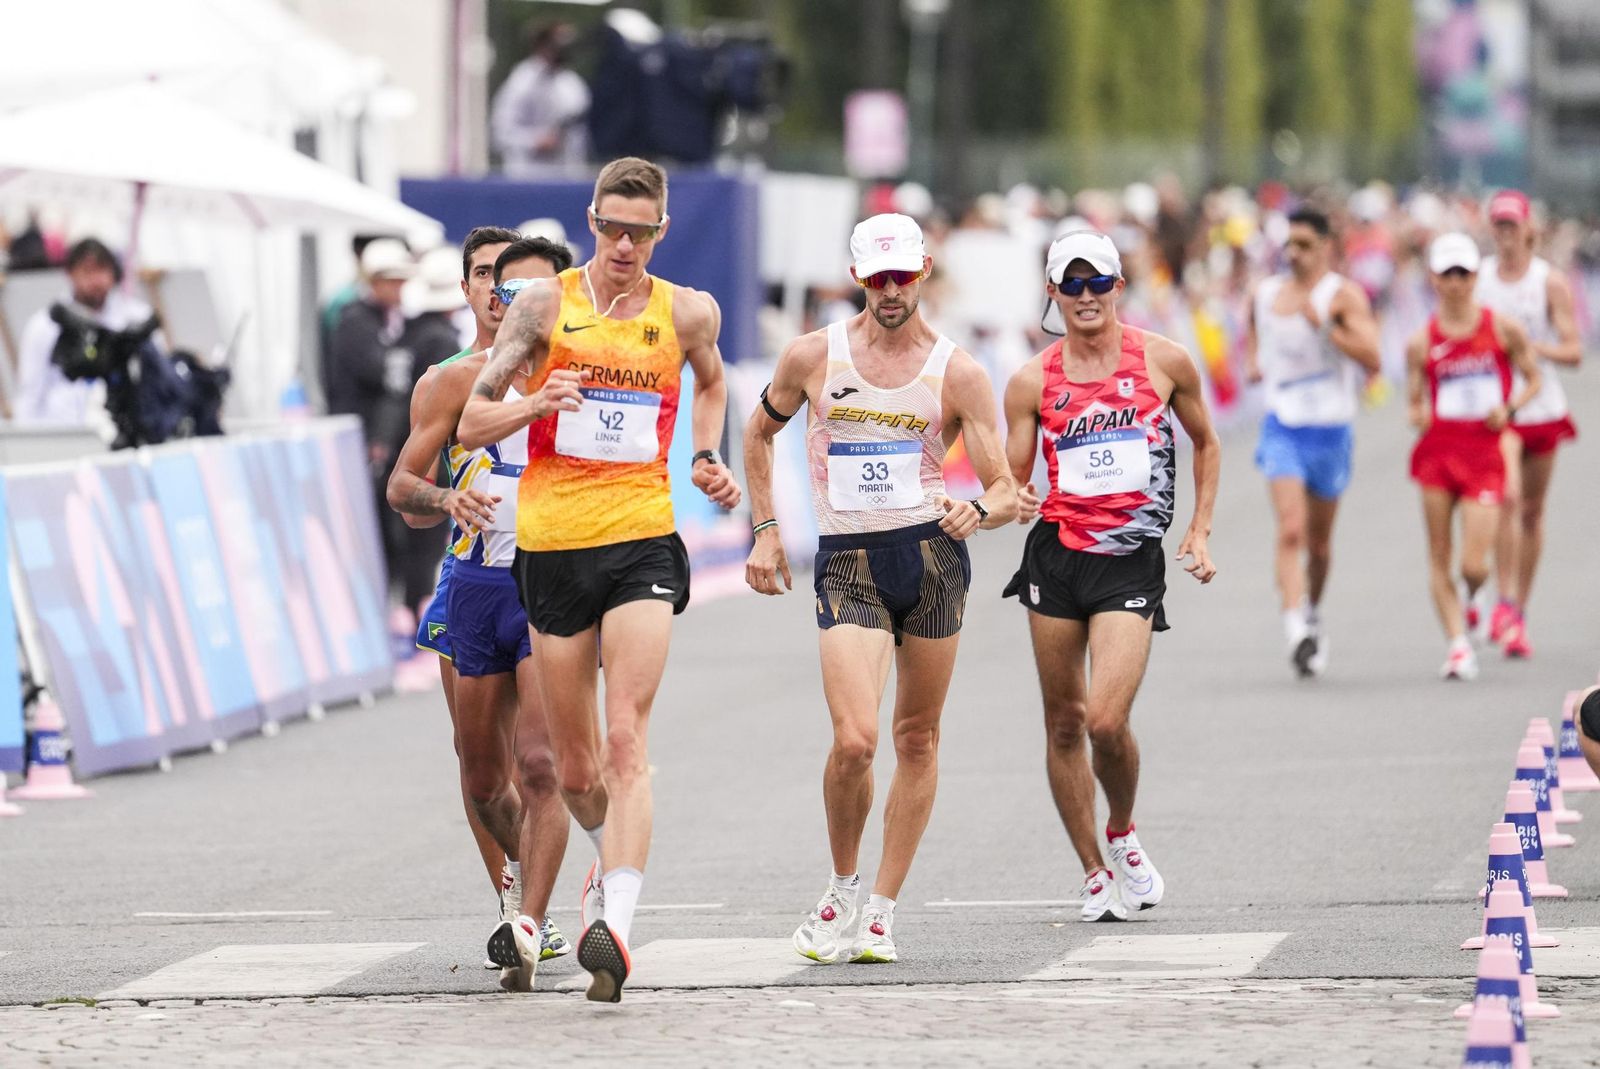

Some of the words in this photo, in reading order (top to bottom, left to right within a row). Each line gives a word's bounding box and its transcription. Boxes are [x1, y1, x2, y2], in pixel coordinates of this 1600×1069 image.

[588, 390, 614, 400] PARIS
[616, 393, 640, 402] 2024
[599, 409, 625, 431] 42
[827, 406, 930, 433] ESPAÑA
[1061, 407, 1137, 439] JAPAN
[595, 432, 622, 443] LINKE
[1076, 434, 1100, 445] PARIS
[1101, 431, 1123, 441] 2024
[850, 445, 875, 453] PARIS
[876, 444, 898, 452] 2024
[1089, 449, 1115, 468] 58
[861, 462, 889, 481] 33
[1084, 468, 1124, 480] KAWANO
[858, 483, 894, 493] MARTIN
[1517, 825, 1538, 838] RIS
[1521, 837, 1538, 849] 24
